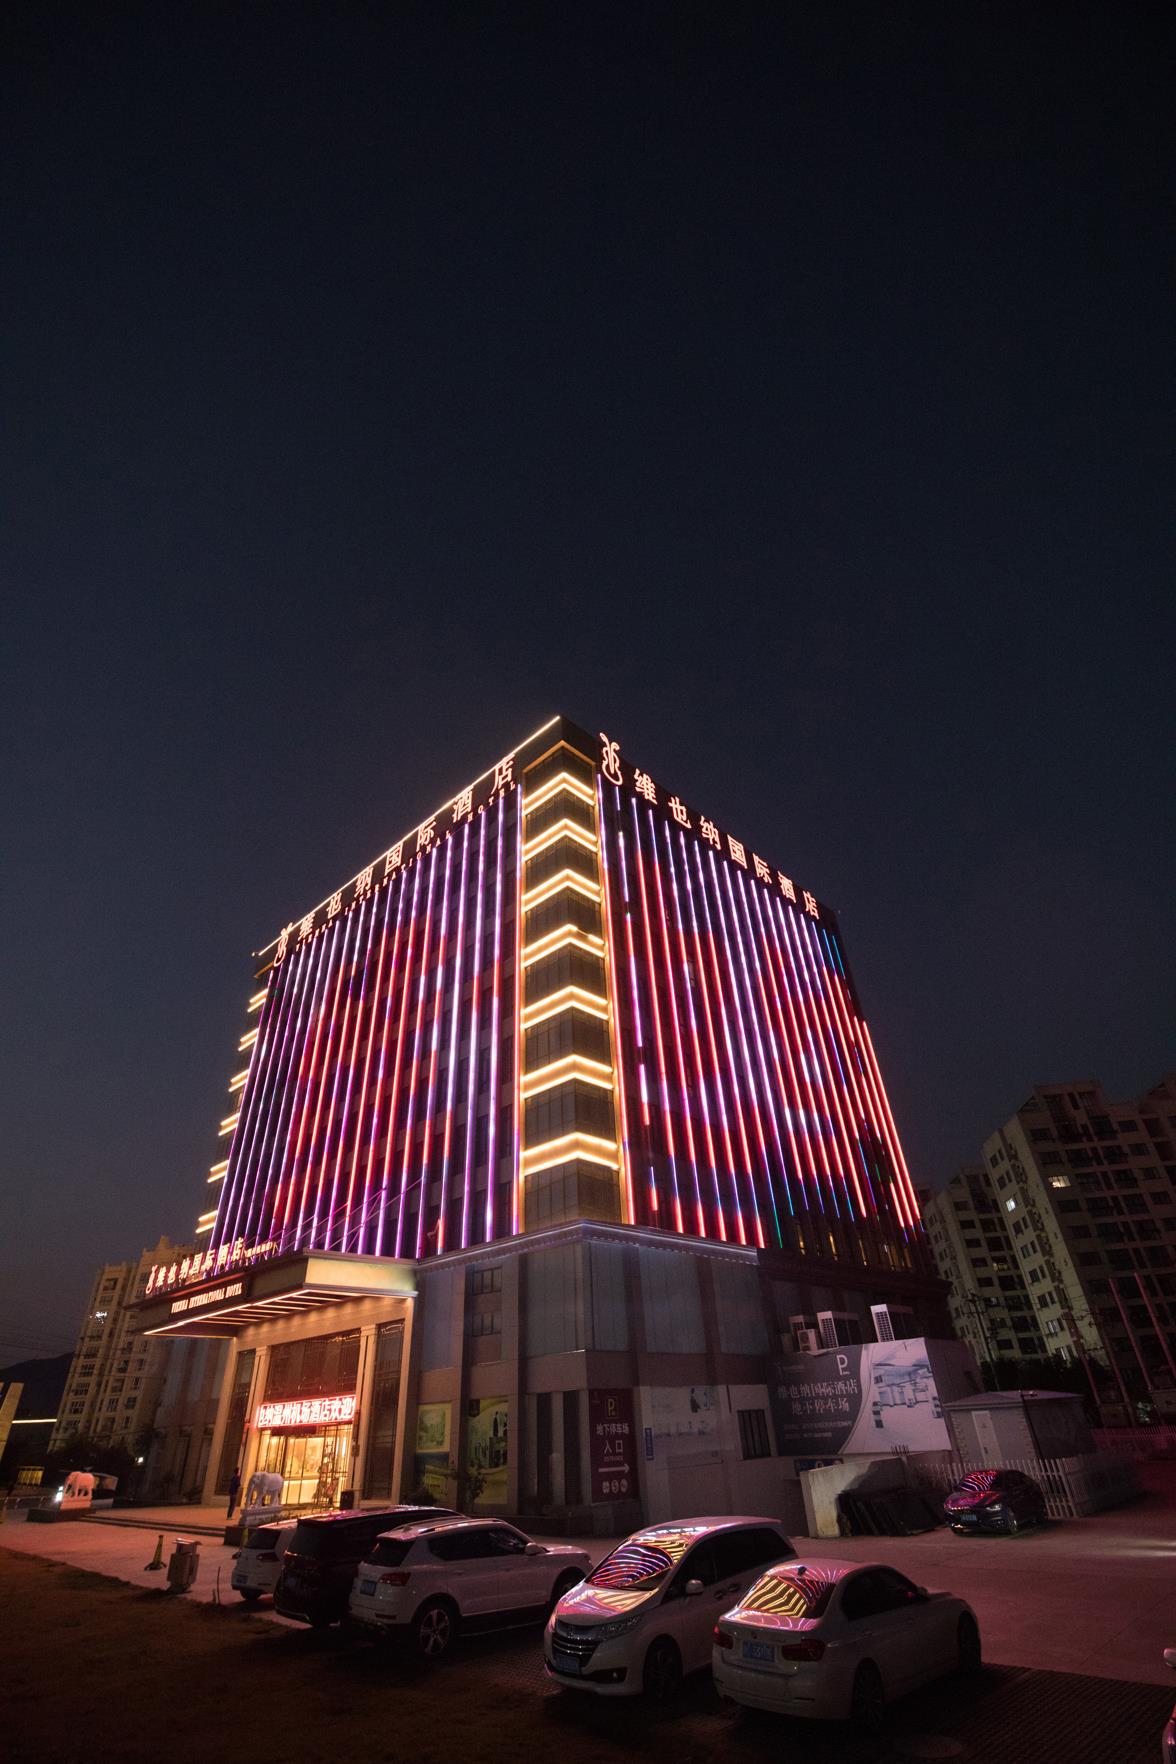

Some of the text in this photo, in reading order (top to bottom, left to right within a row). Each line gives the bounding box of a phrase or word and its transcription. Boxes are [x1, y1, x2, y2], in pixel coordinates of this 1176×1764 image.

[299, 753, 516, 938] 维也纳国际酒店
[633, 768, 820, 919] 维也纳国际酒店
[596, 1423, 630, 1436] 地下停车场
[603, 1439, 624, 1454] 入口
